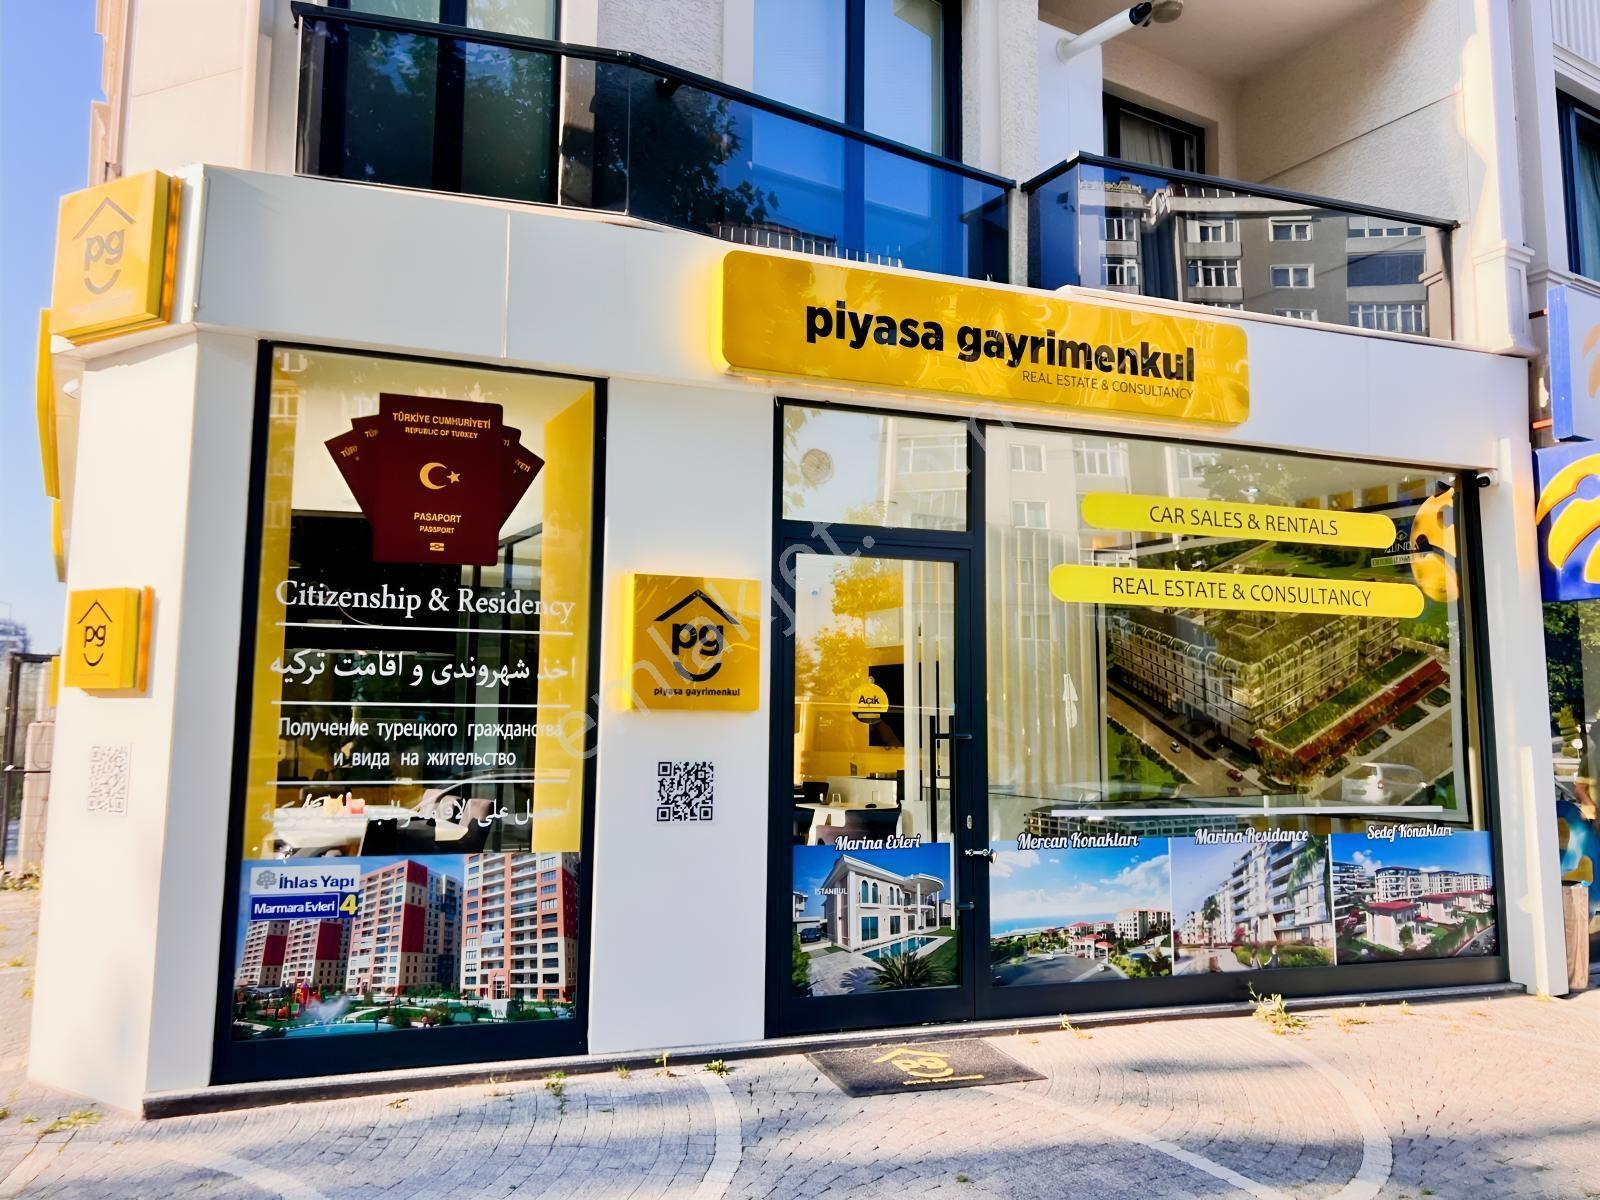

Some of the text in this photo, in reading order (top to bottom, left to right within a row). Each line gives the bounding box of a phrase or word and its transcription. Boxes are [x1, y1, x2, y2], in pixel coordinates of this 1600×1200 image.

[84, 228, 126, 271] pg
[806, 300, 1196, 383] piyasa gayrimenkul
[1022, 370, 1195, 400] REAL ESTATE & CONSULTANCY
[392, 411, 491, 429] TÜRKİYE CUMHURİYETİ
[405, 426, 439, 436] REPUBLIC
[451, 430, 478, 439] TURKEY
[413, 511, 462, 523] PASAPORT
[1149, 506, 1339, 537] CAR SALES & RENTALS
[419, 525, 455, 534] PASSPORT
[275, 580, 576, 624] Citizenship & Residency
[1112, 577, 1371, 608] REAL ESTATE & CONSULTANCY
[84, 625, 106, 648] pg
[672, 623, 724, 656] pg
[410, 662, 424, 686] و
[538, 655, 576, 681] اخذ
[653, 687, 740, 698] piyasa gayrimenkul
[858, 695, 880, 707] Açık
[278, 716, 563, 742] Получение турецкого гражданства
[333, 752, 517, 769] и вида на жительство
[834, 833, 922, 851] Marina Evleri
[1017, 831, 1141, 851] Mercan Konakları
[1194, 826, 1310, 846] Marina Residance
[1367, 823, 1454, 842] Sedef Konakları
[279, 872, 355, 893] İhlas Yapı
[254, 894, 358, 916] Marmara Evleri 4
